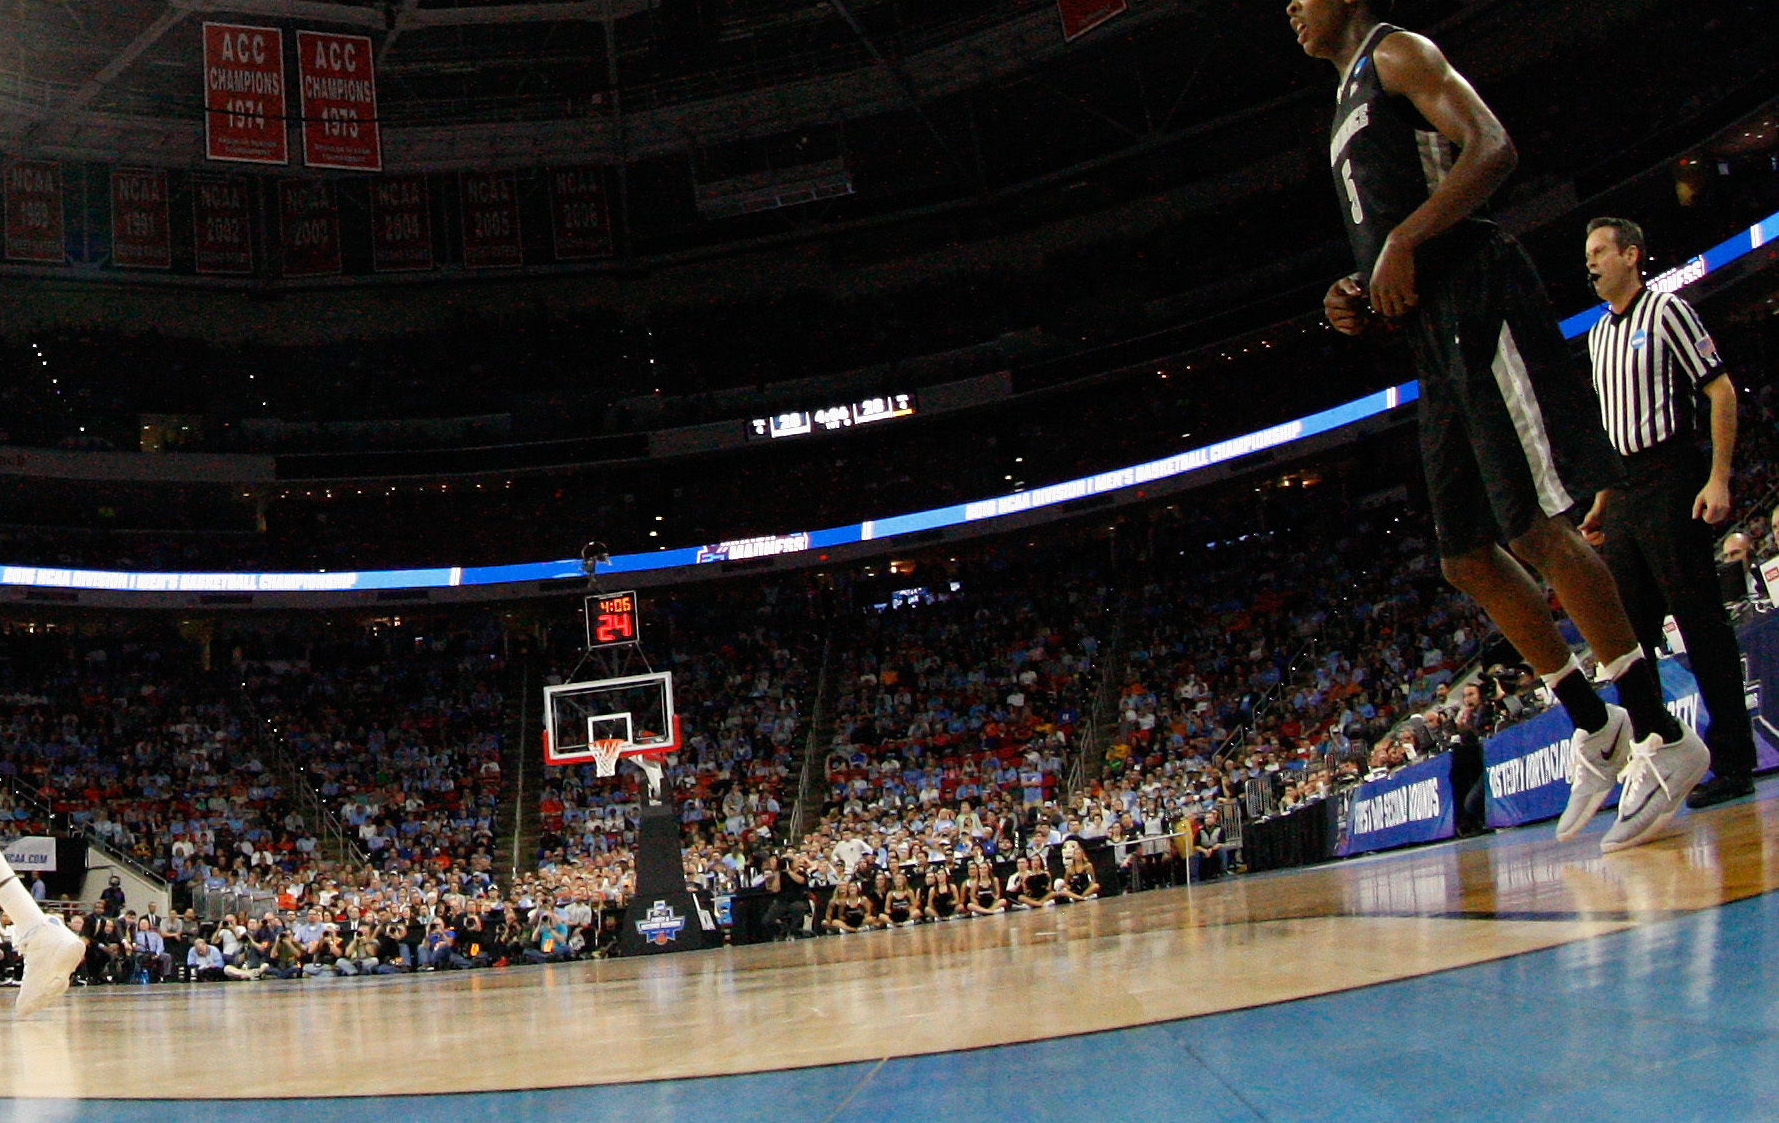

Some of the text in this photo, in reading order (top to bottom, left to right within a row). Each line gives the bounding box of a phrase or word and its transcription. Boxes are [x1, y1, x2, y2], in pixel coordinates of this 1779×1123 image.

[221, 31, 265, 65] ACC
[314, 40, 357, 73] ACC
[208, 66, 281, 96] CHAMPIONS
[304, 74, 372, 103] CHAMPIONS
[226, 99, 265, 130] 1974
[1340, 158, 1364, 225] 5
[997, 493, 1031, 515] NCAA
[1032, 481, 1085, 507] DIVISION
[1094, 466, 1135, 492] MEN'S
[1135, 448, 1209, 483] BASKETBALL
[1209, 420, 1303, 465] CHAMPIONSHIP
[728, 535, 807, 561] MADNESS
[72, 569, 127, 589] DIVISION
[179, 572, 257, 591] BASKETBALL
[259, 571, 358, 590] CHAMPIONSHIP
[596, 613, 633, 642] 24
